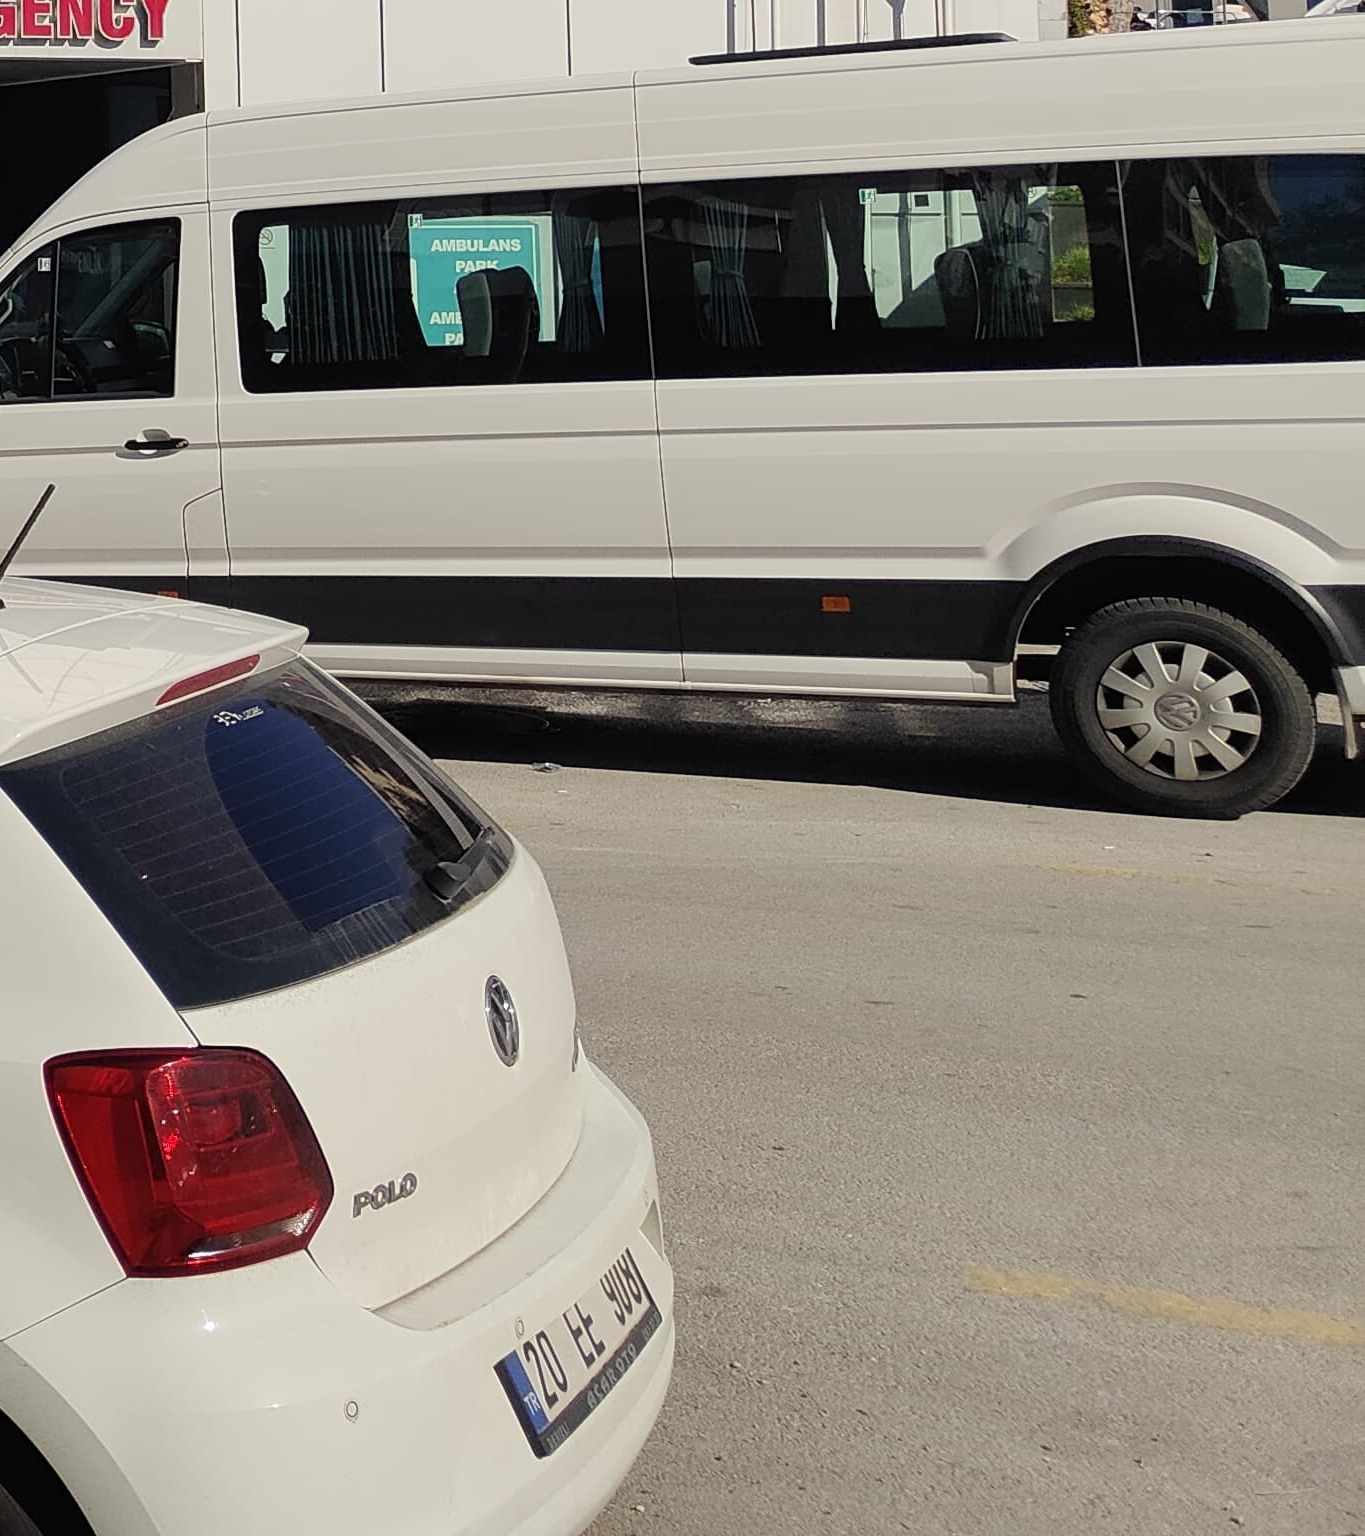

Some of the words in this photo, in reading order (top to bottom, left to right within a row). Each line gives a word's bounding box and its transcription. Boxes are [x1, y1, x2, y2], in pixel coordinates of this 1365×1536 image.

[430, 238, 522, 252] AMBULANS
[351, 1172, 418, 1218] POLO
[599, 1248, 644, 1327] 908
[562, 1302, 607, 1369] EE
[521, 1330, 569, 1410] 20
[523, 1390, 542, 1415] TR
